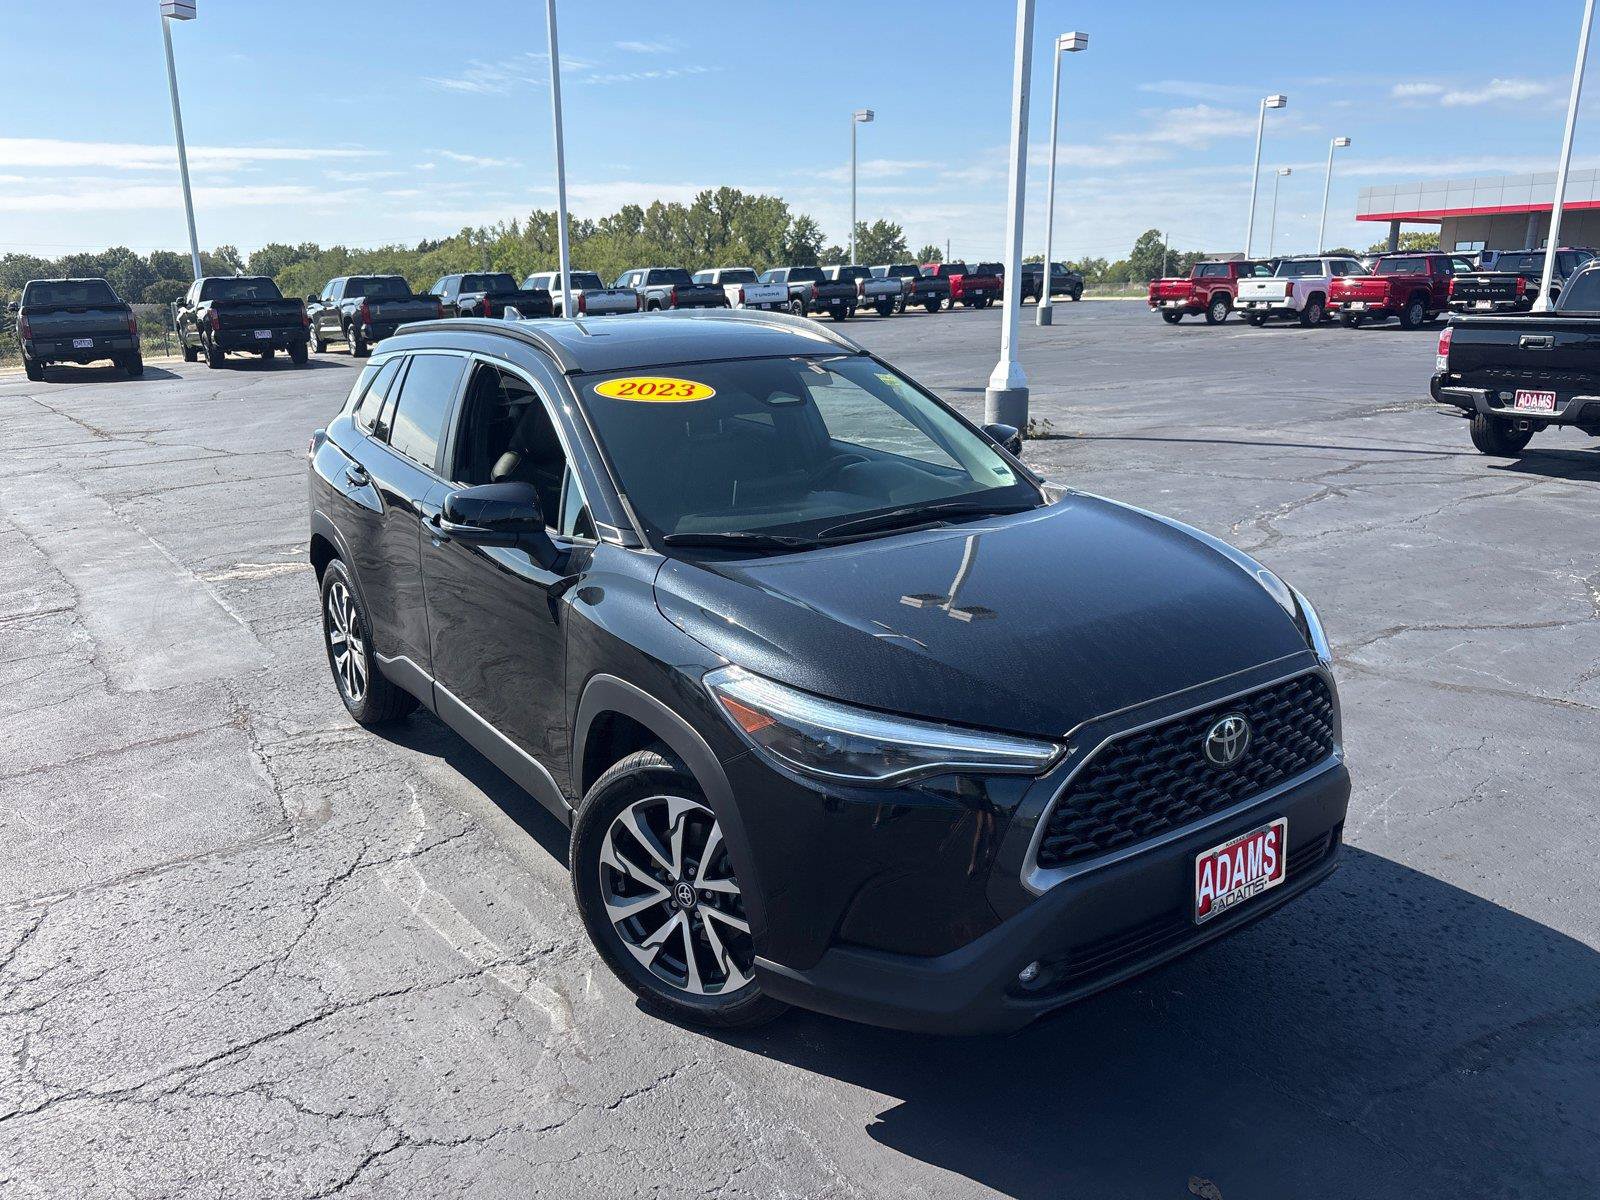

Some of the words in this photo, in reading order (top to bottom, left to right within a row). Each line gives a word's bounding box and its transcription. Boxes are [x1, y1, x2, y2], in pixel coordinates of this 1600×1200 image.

[617, 382, 696, 397] 2023
[1518, 393, 1553, 409] ADAMS
[1199, 831, 1276, 908] ADAMS
[1218, 878, 1265, 910] ADAMS
